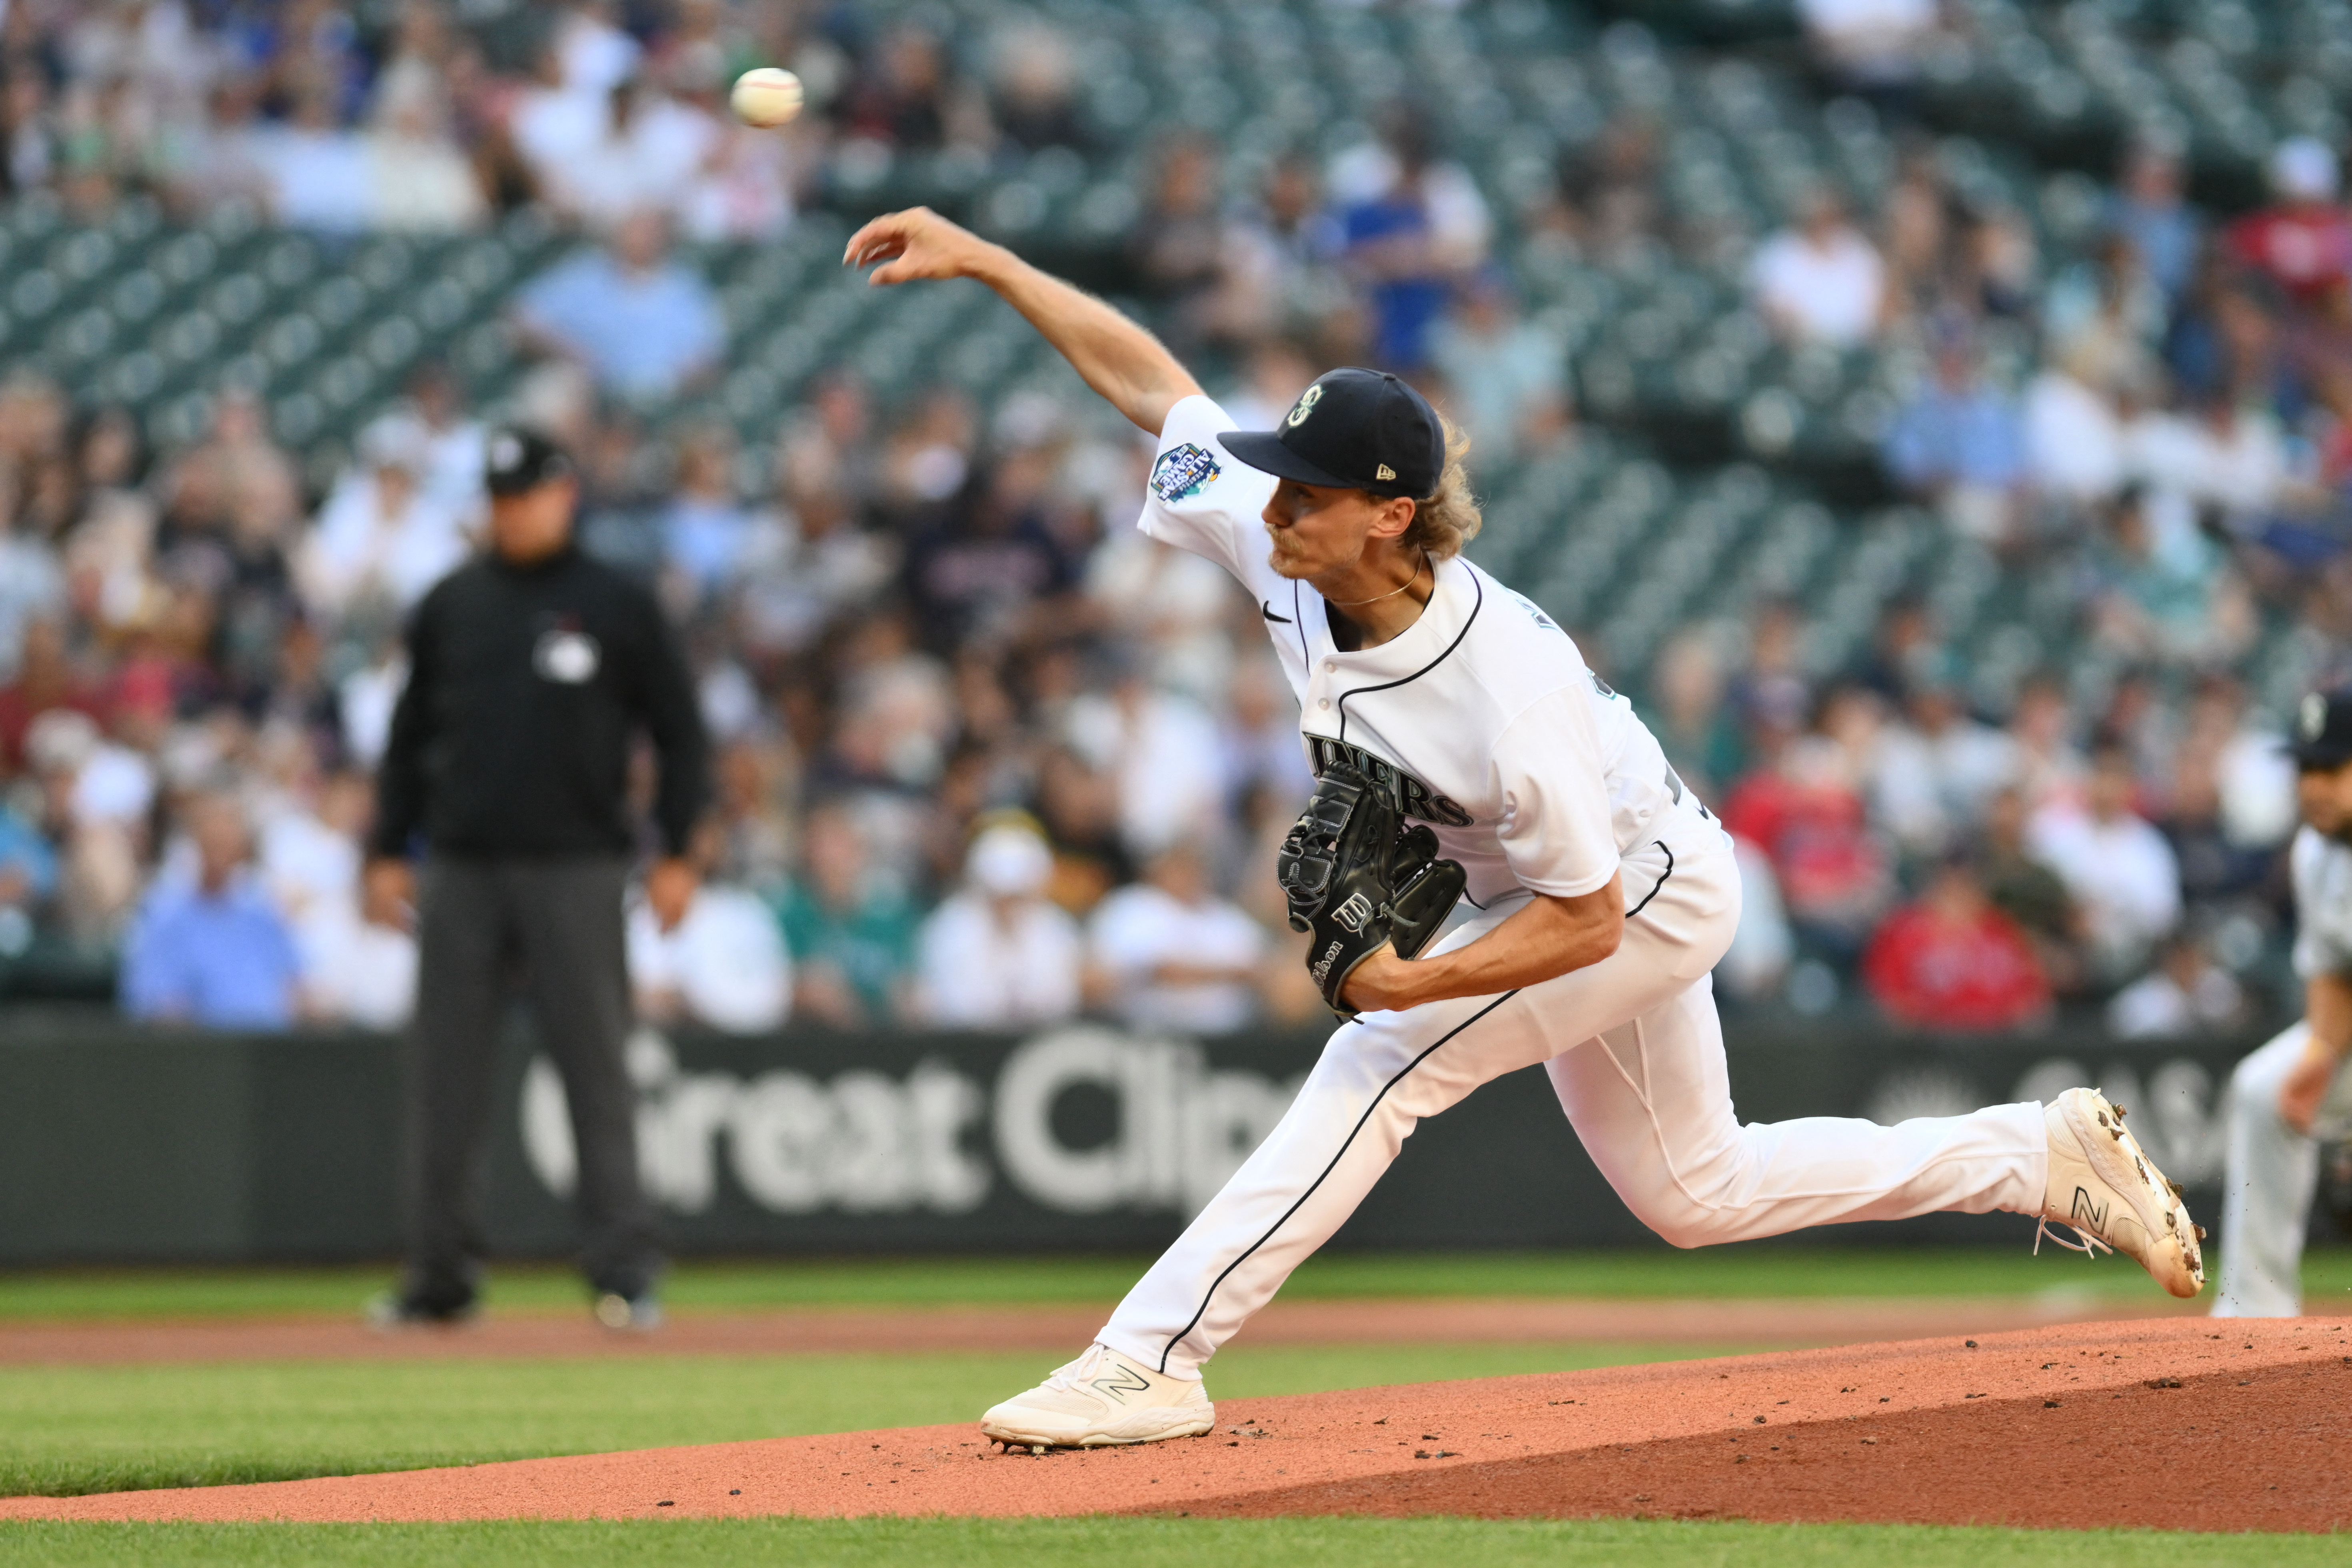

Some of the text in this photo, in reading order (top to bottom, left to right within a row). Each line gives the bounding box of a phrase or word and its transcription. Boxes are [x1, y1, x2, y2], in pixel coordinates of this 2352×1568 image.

[1158, 450, 1211, 499] ALL STAR
[1160, 453, 1195, 486] GAME
[1178, 470, 1204, 491] SEATTLE
[992, 1022, 1313, 1240] Clip
